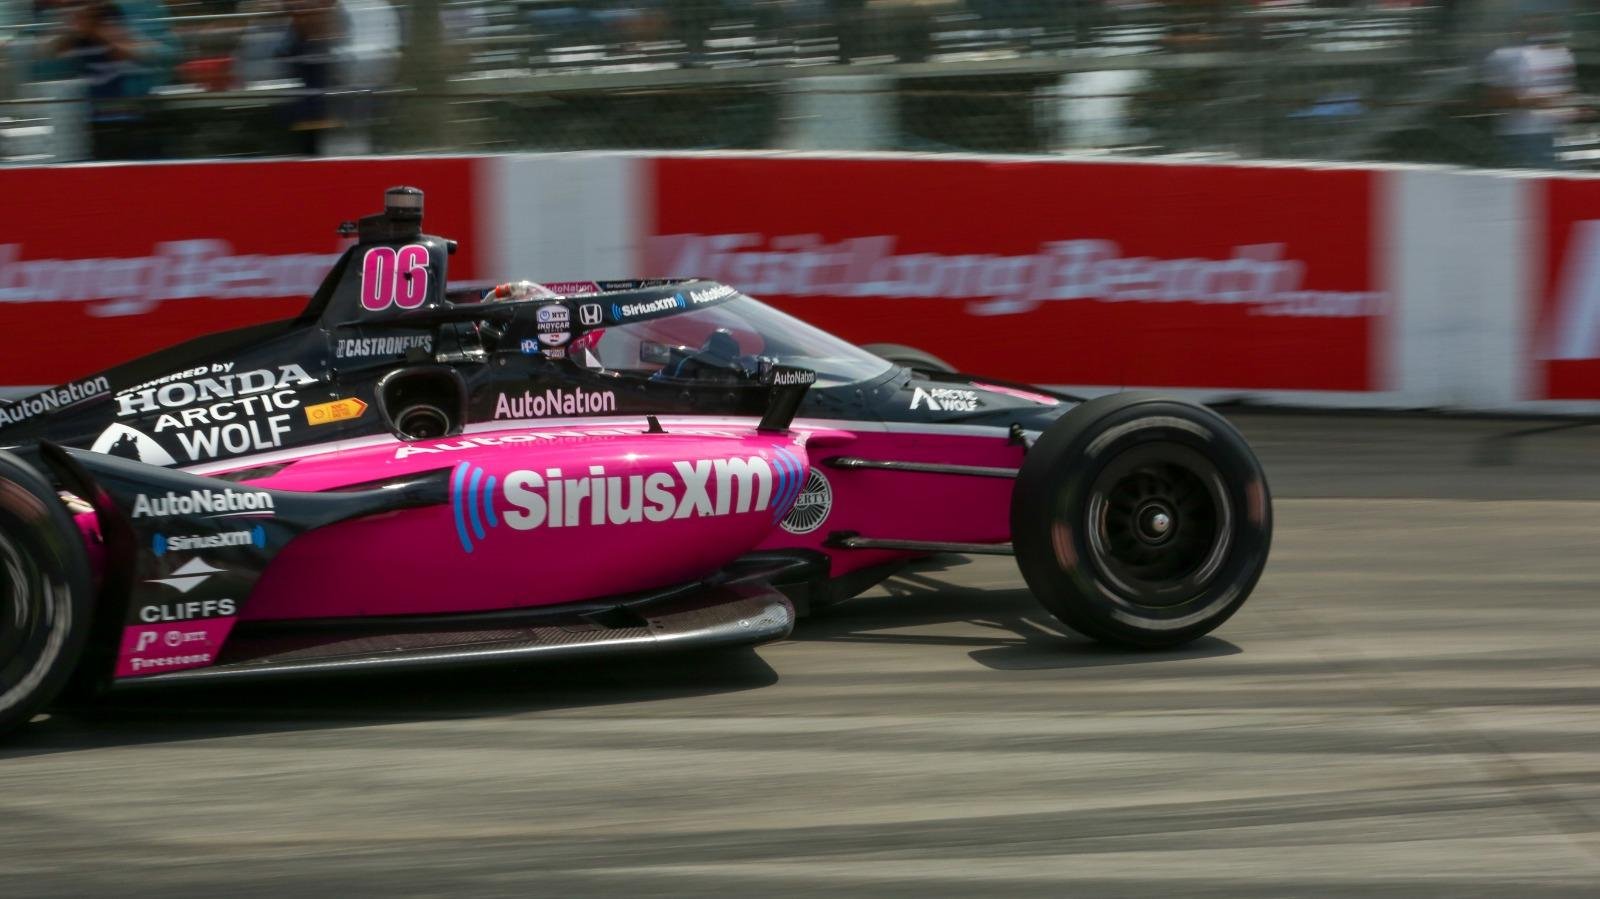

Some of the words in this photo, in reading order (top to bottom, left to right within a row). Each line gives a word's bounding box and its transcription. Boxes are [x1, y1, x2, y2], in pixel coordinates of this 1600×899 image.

[361, 244, 430, 311] 06
[538, 321, 570, 330] INDYCAR
[552, 311, 566, 319] NTT
[114, 364, 320, 417] HONDA
[116, 366, 209, 396] POWERED
[211, 361, 235, 374] by
[774, 370, 815, 385] AutoNation
[0, 375, 110, 428] AutoNation
[153, 389, 301, 433] ARCTIC
[495, 388, 616, 420] AutoNation
[939, 399, 977, 412] WOLF
[176, 414, 291, 462] WOLF
[132, 488, 275, 518] AutoNation
[797, 491, 826, 505] ERTY
[140, 598, 236, 623] CLIFFS
[130, 653, 211, 671] Firestone
